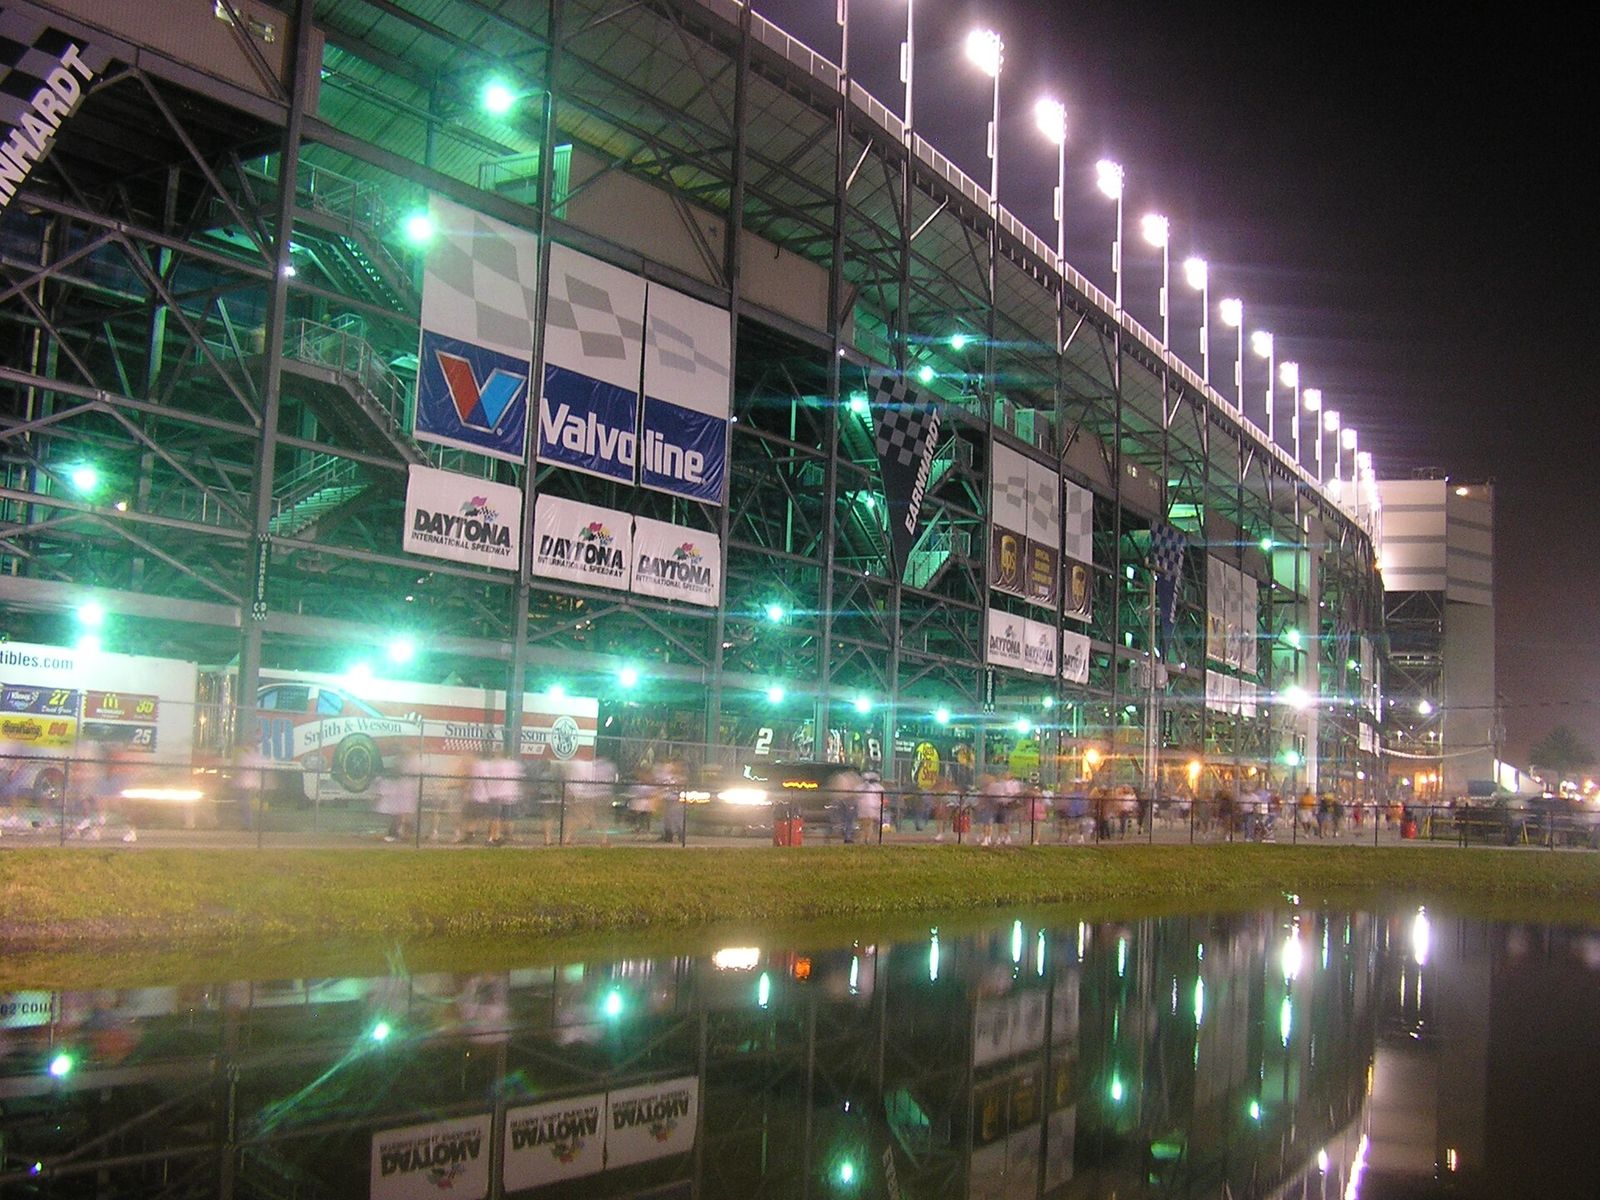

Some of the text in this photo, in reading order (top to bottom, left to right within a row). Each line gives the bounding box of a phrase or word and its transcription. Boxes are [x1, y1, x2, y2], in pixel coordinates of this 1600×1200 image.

[0, 43, 94, 209] NHARDT
[525, 396, 705, 484] Valvoline
[905, 407, 941, 535] EARNHARDT
[413, 508, 511, 548] DAYTONA
[411, 531, 512, 557] INTERNATIONAL SPEEDWAY
[538, 534, 624, 571] DAYTONA
[637, 554, 712, 587] DAYTONA
[48, 689, 71, 706] 27
[132, 729, 151, 745] 25
[304, 718, 402, 746] Smith & Wesson
[444, 723, 483, 739] Smith
[755, 727, 774, 755] 2
